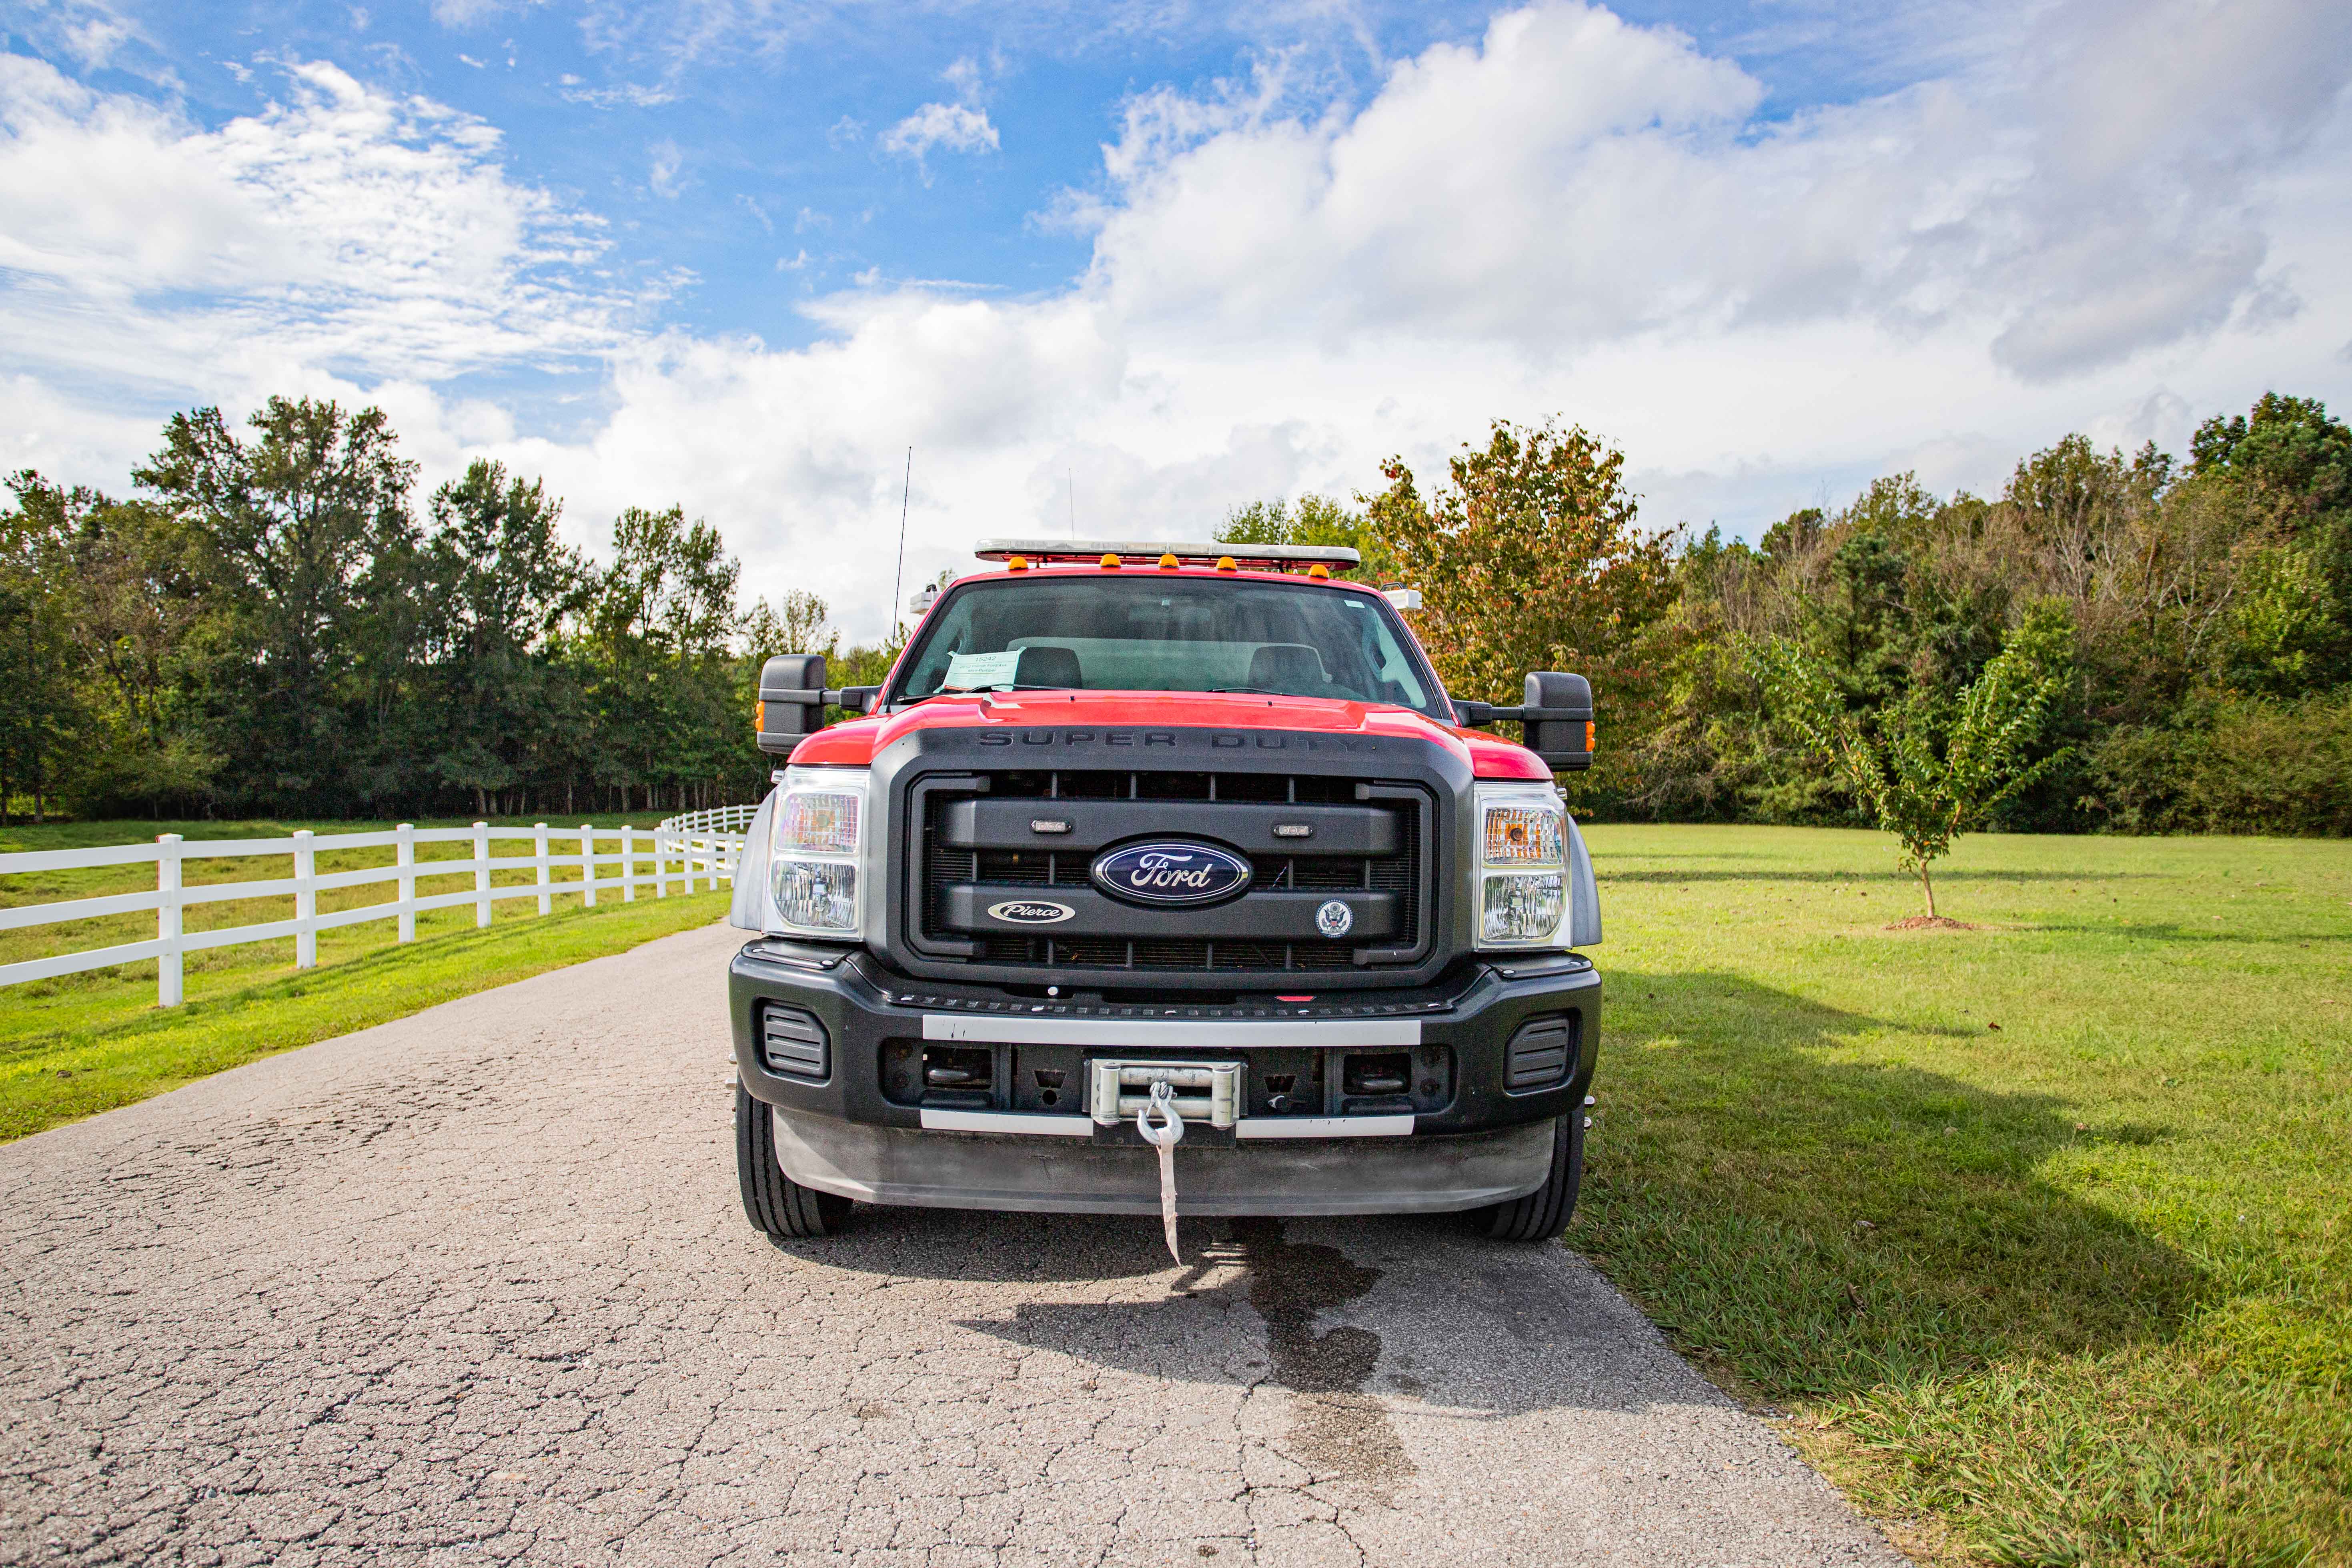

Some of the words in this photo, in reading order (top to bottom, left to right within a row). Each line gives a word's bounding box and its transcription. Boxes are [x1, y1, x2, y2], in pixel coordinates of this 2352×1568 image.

[979, 731, 1177, 747] SUPER
[1210, 733, 1361, 753] DUTY
[1130, 853, 1213, 888] Ford
[1004, 905, 1060, 917] Pierce
